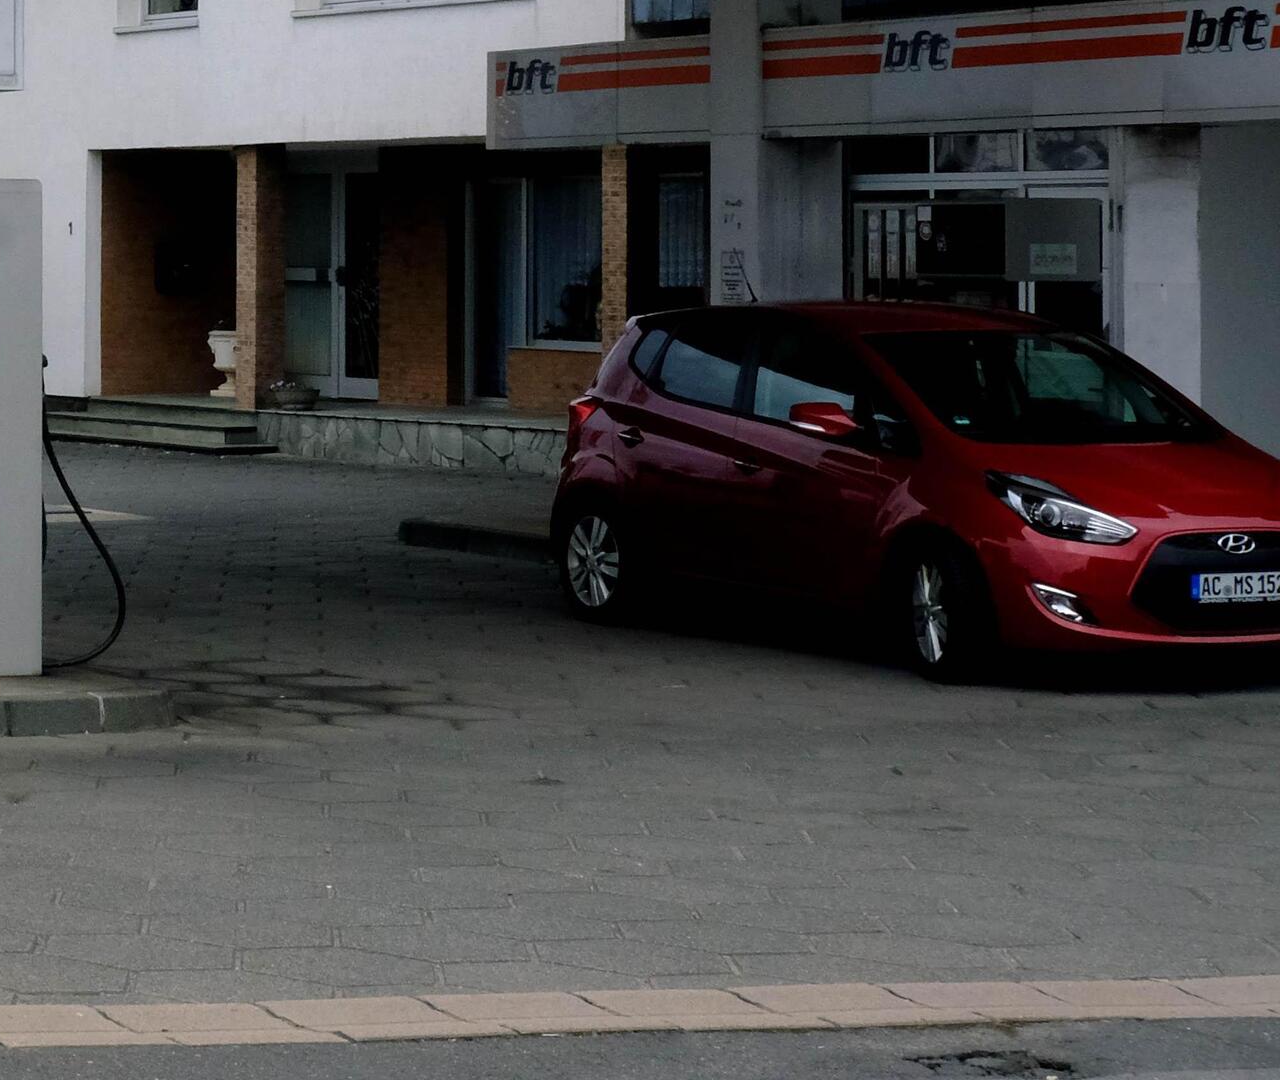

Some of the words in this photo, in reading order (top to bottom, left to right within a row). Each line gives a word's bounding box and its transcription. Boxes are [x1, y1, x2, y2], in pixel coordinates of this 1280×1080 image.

[1185, 5, 1270, 54] bft
[883, 30, 951, 73] bft
[506, 58, 557, 96] bft
[1202, 576, 1221, 596] AC
[1234, 575, 1253, 595] MS
